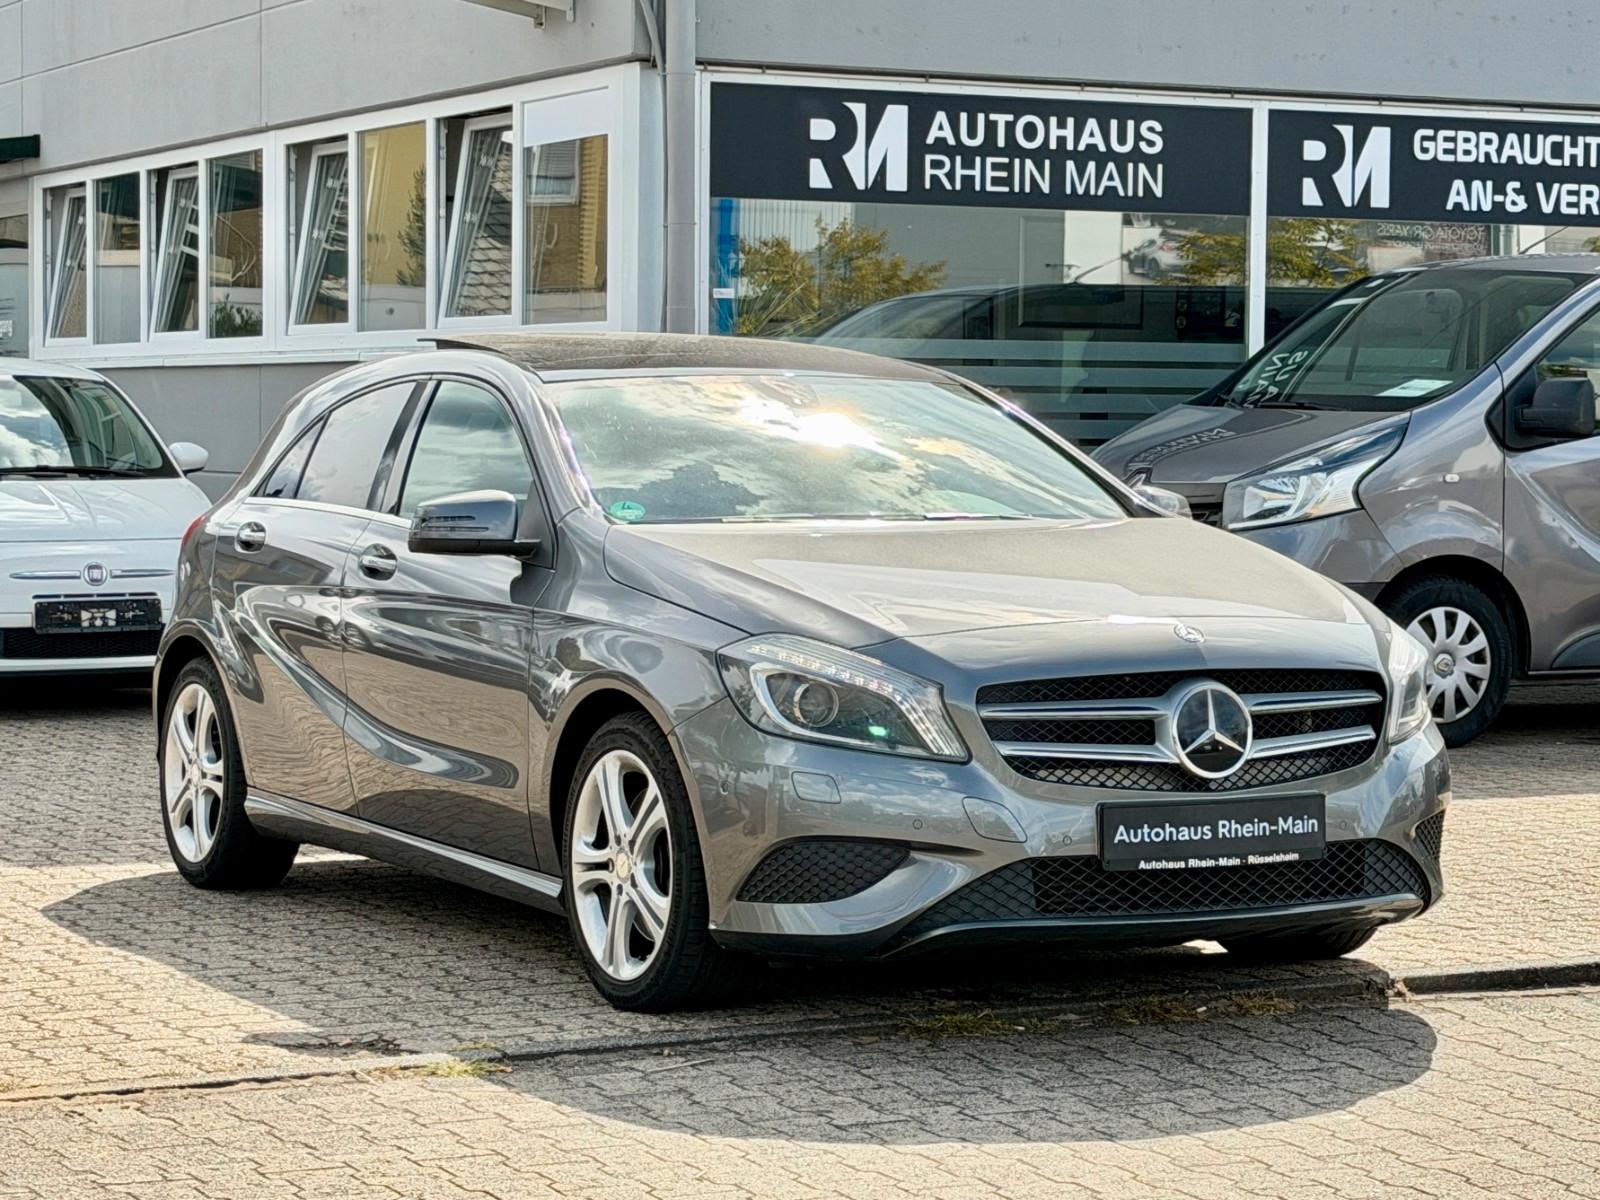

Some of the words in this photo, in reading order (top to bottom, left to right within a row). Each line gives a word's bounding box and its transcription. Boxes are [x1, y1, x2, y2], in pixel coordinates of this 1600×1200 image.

[926, 111, 1164, 155] AUTOHAUS
[1413, 128, 1600, 168] GEBRAUCHT
[924, 154, 1050, 194] RHEIN
[1065, 159, 1164, 198] MAIN
[1535, 182, 1600, 215] VER
[1113, 822, 1212, 844] Autohaus
[1218, 815, 1319, 839] Rhein-Main
[1138, 860, 1186, 870] Autohaus
[1188, 857, 1241, 868] Rhein-Main
[1247, 852, 1300, 865] Rüsselsheim
